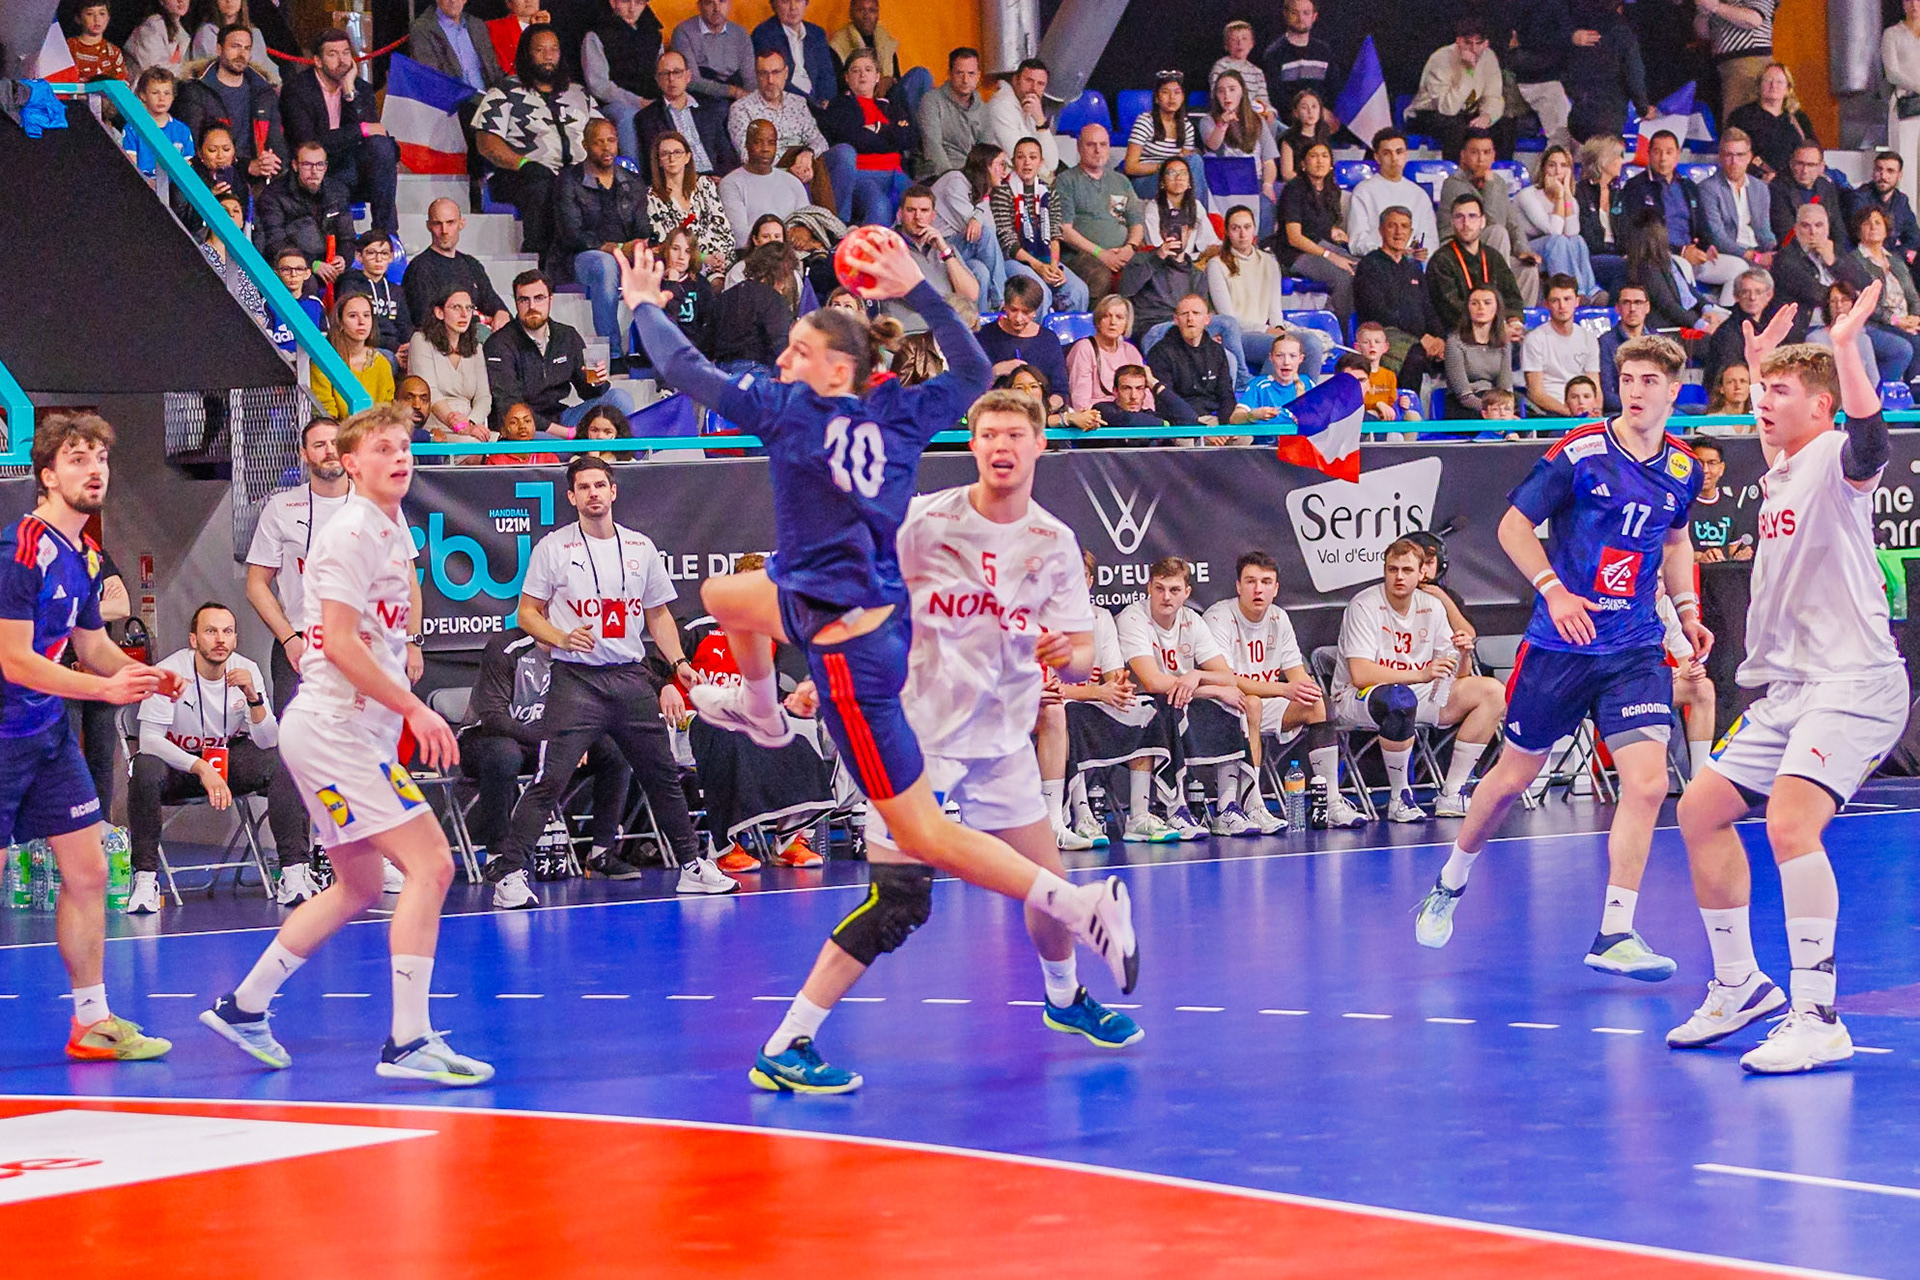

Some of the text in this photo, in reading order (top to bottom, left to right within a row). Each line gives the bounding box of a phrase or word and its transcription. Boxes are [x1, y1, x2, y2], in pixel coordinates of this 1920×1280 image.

[823, 415, 888, 499] 10
[488, 508, 530, 518] HANDBALL
[1300, 491, 1424, 542] Serris
[1621, 501, 1652, 538] 17
[494, 517, 531, 533] U21M
[1317, 548, 1340, 564] Val
[981, 551, 997, 588] 5
[422, 614, 503, 635] D'EUROPE
[605, 610, 621, 626] A
[1161, 648, 1179, 673] 19
[1247, 639, 1264, 663] 10
[1621, 702, 1672, 718] ACADOMIA
[209, 757, 222, 772] C
